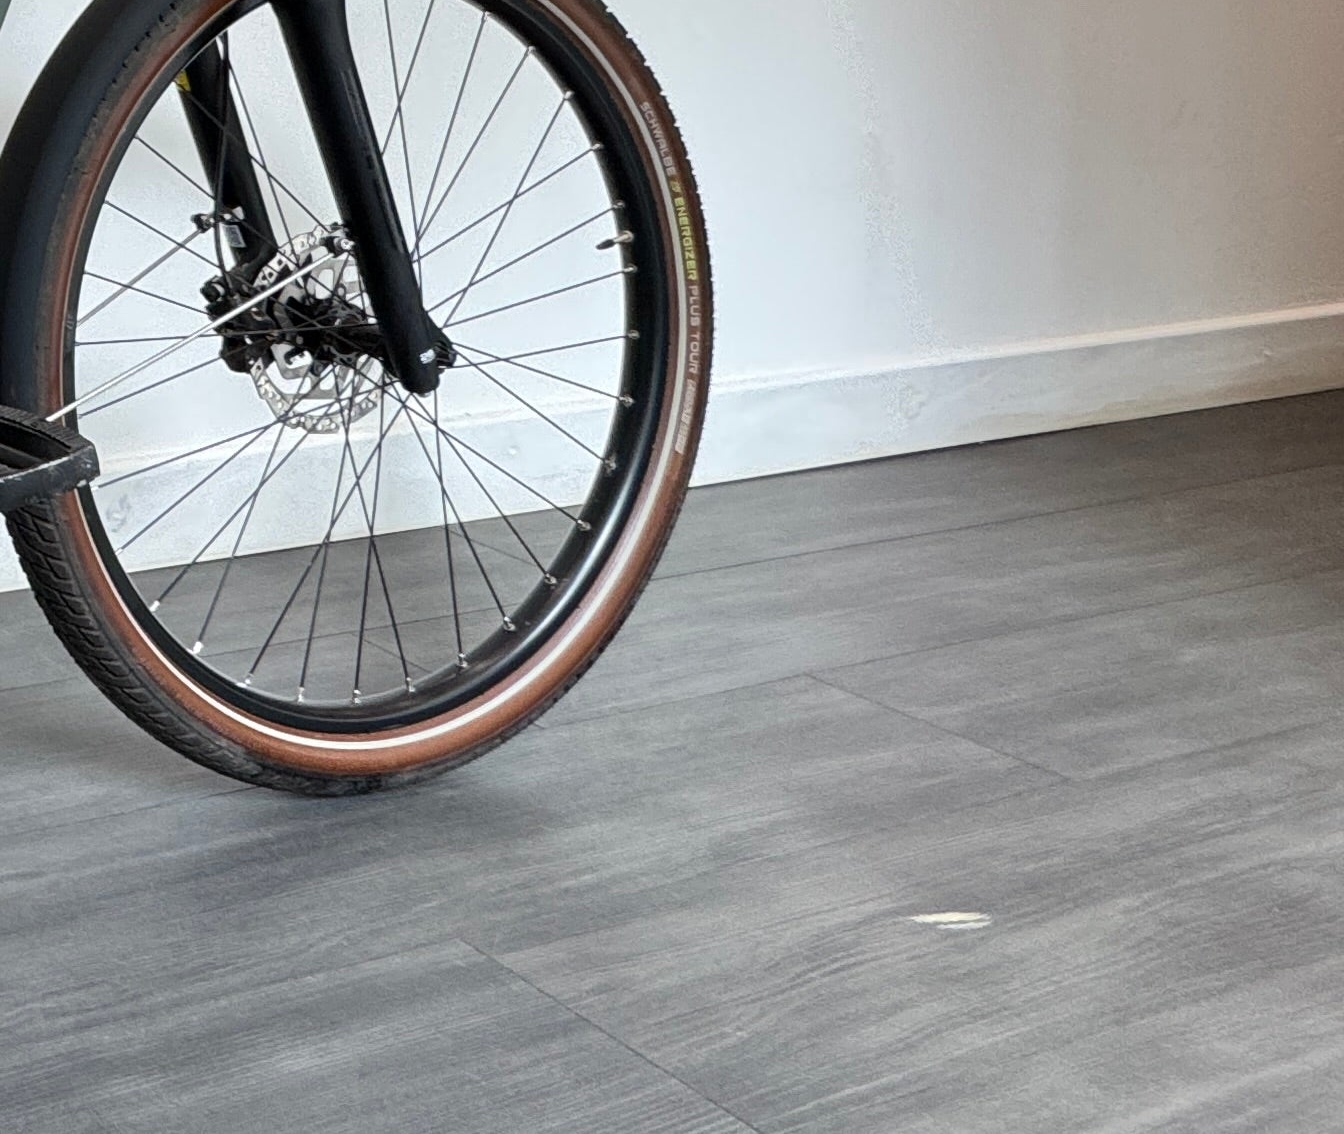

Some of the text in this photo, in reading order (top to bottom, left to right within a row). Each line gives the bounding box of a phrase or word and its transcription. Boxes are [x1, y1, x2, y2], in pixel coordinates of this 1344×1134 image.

[640, 101, 701, 374] SCHWALBE ENERGIZER PLUS TOUR
